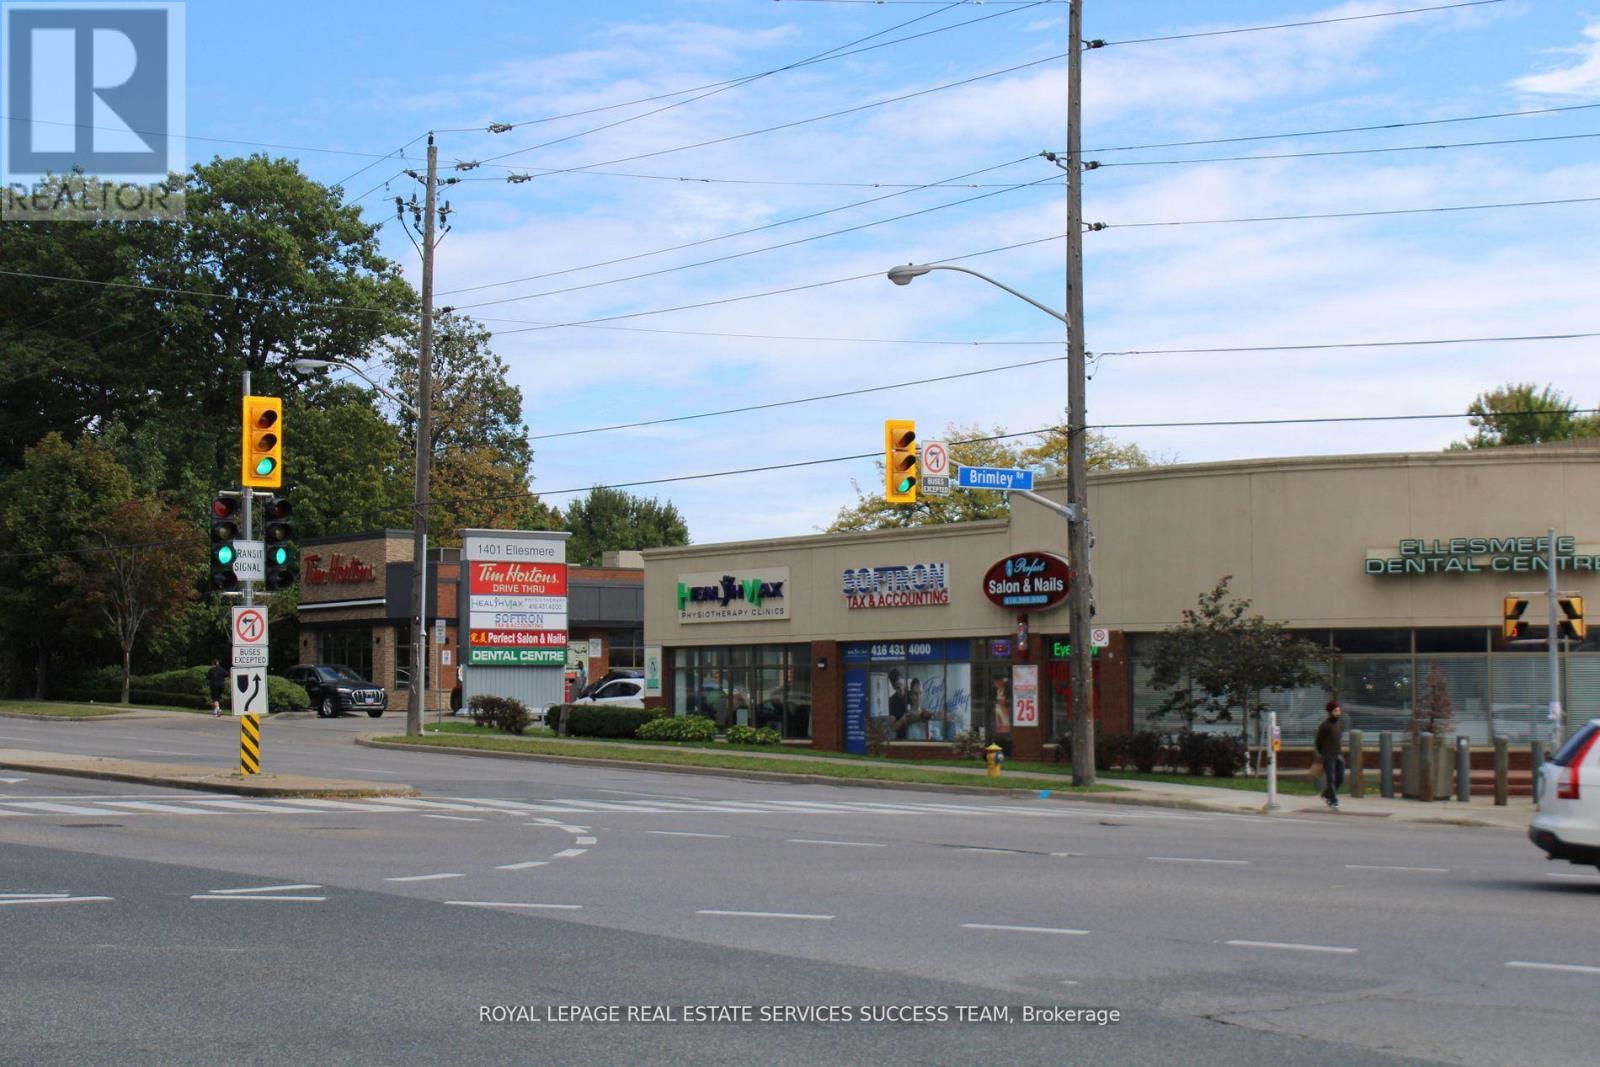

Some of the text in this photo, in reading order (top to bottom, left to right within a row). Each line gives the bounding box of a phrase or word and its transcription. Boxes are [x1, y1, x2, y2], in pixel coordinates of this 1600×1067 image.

[969, 470, 1013, 488] Brimley
[478, 544, 555, 556] 1401 Ellesmere
[234, 561, 262, 572] SIGNAL
[1014, 557, 1045, 577] Perfect
[1365, 556, 1481, 575] DENTAL
[478, 563, 504, 582] Tim
[842, 563, 945, 594] SOFTRON
[493, 584, 545, 594] DRIVE THRU
[988, 577, 1064, 595] Salon & Nails
[846, 589, 949, 608] TAX & ACCOUNTING
[494, 613, 544, 624] SOFTRON
[681, 607, 785, 619] PHYSIOTHERAPY CLINICS
[488, 632, 515, 644] Perfect
[516, 632, 538, 644] Salon
[540, 633, 546, 644] &
[547, 633, 566, 644] Nails
[239, 648, 261, 656] BUSES
[472, 650, 565, 661] DENTAL CENTRE
[871, 644, 886, 656] 416
[889, 643, 905, 656] 431
[909, 643, 931, 655] 4000
[234, 656, 267, 664] EXCEPTED
[1016, 699, 1035, 721] 25
